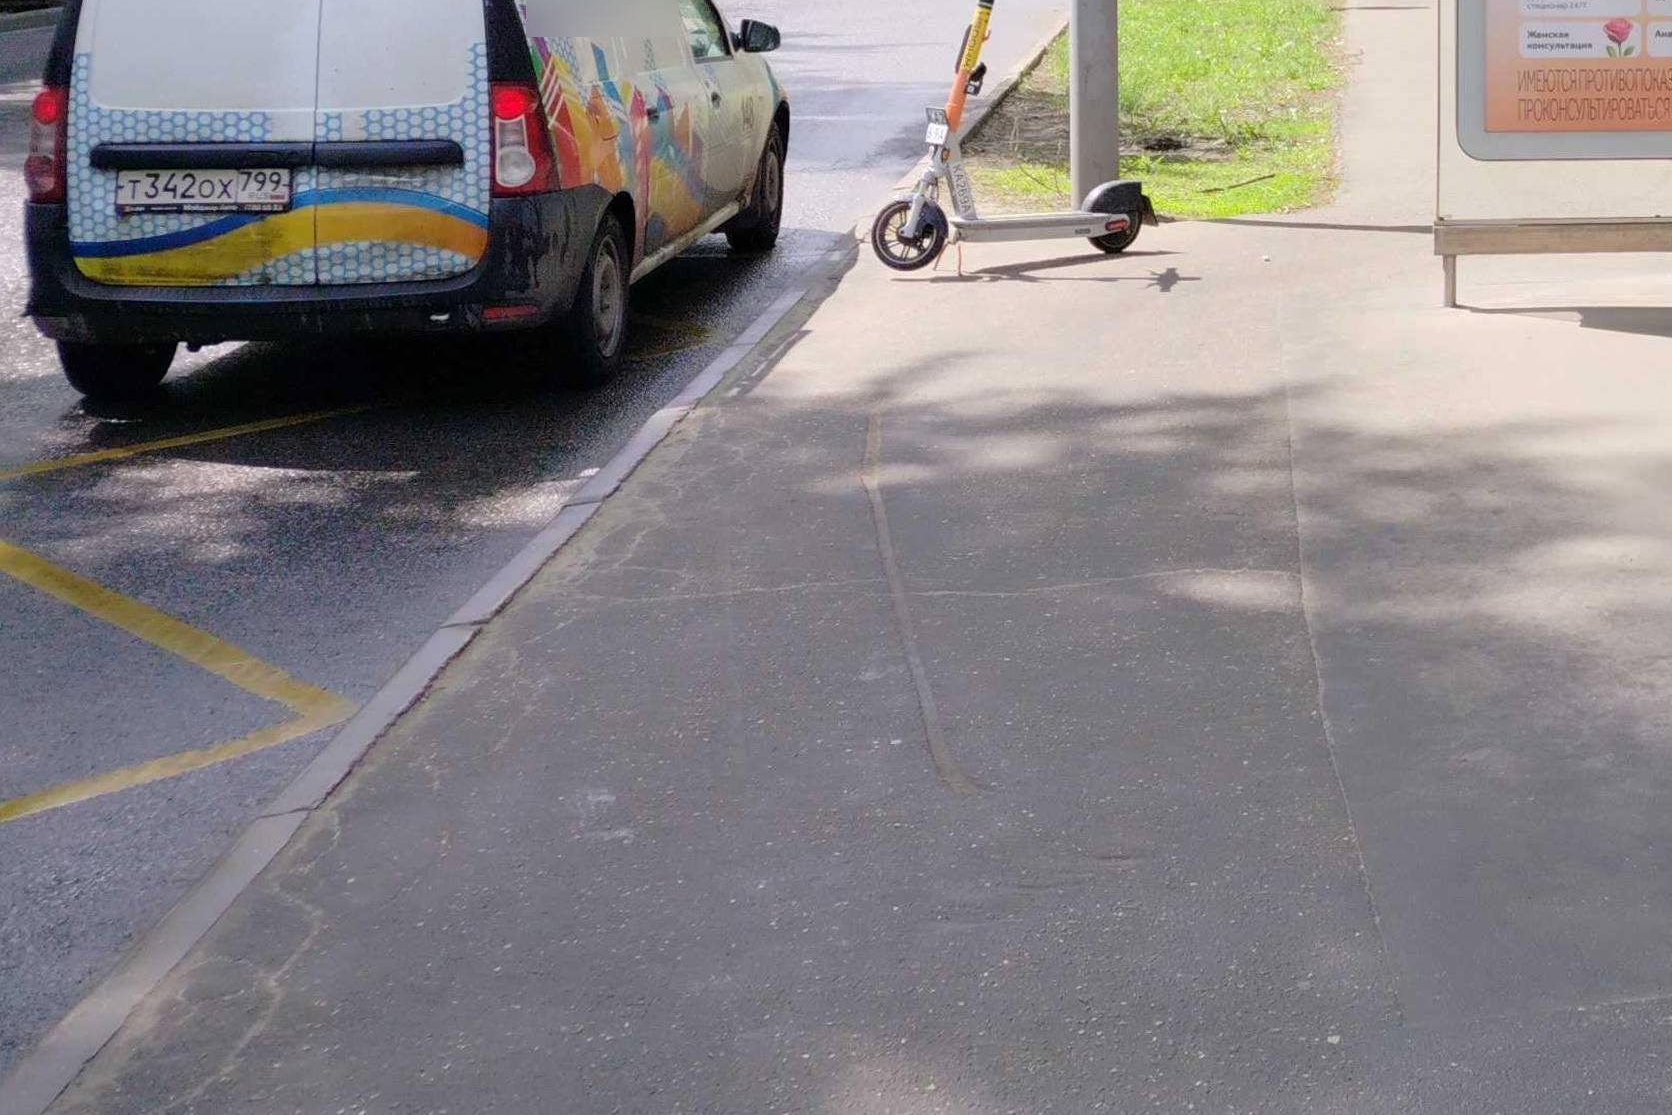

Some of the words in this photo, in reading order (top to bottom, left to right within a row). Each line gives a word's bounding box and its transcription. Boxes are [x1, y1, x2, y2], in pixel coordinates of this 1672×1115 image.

[1527, 30, 1570, 39] Женская
[1527, 41, 1593, 52] консультация
[1517, 68, 1577, 93] ИМЕЮТСЯ
[1517, 96, 1671, 122] ПРОКОНСУЛЬТИРОВАТЬСЯ
[240, 171, 282, 192] 799
